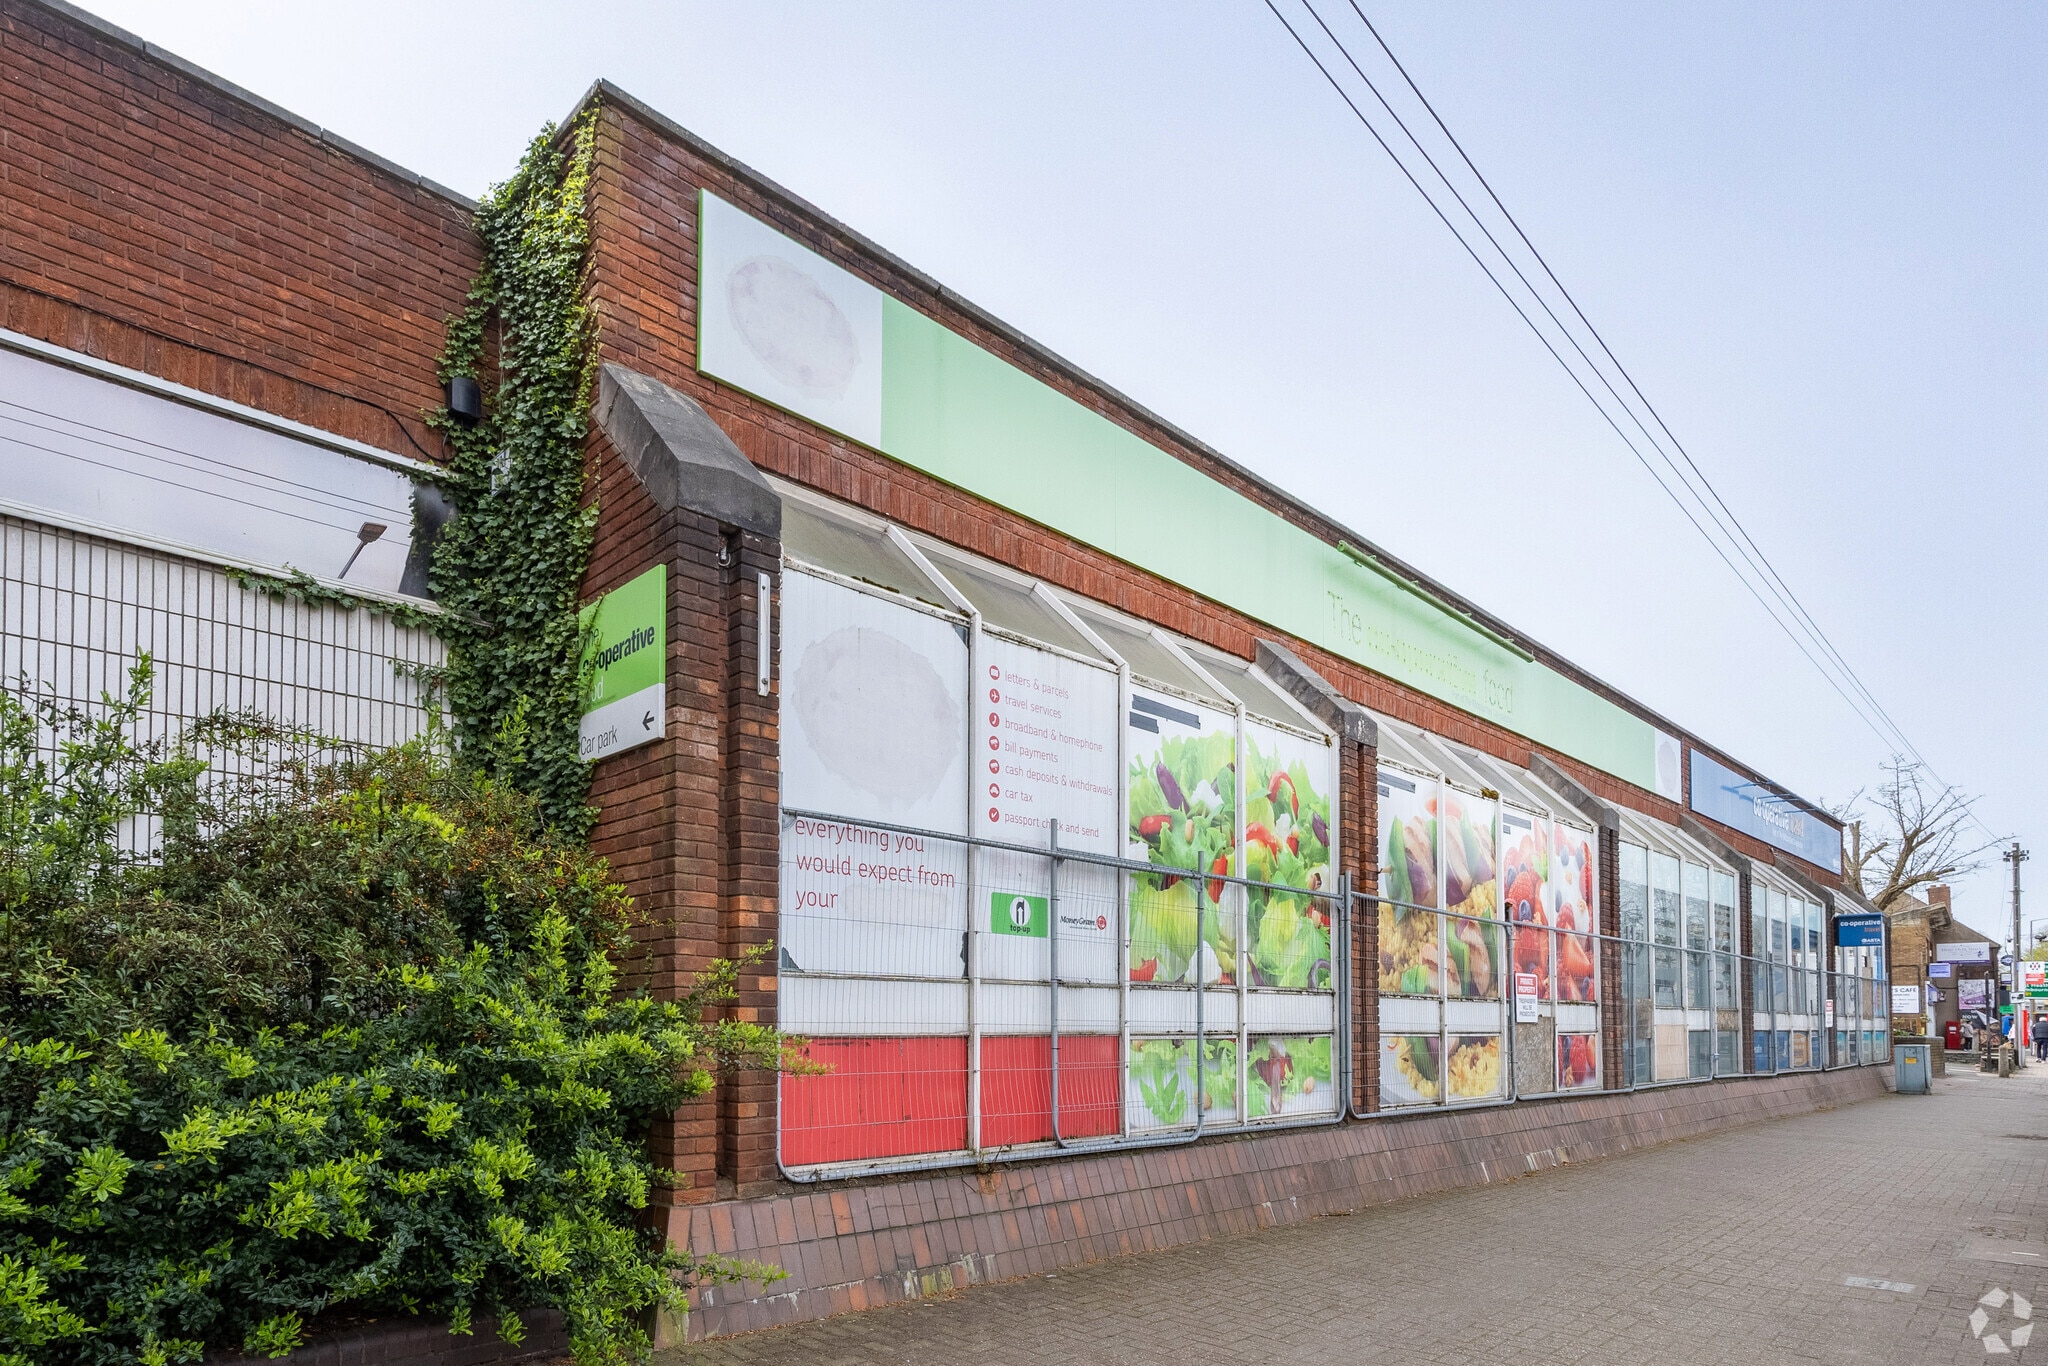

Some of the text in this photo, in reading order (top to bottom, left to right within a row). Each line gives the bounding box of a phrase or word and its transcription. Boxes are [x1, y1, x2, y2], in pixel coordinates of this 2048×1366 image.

[582, 626, 655, 677] c-operative
[1004, 670, 1070, 700] letters & parcels
[1004, 695, 1062, 719] travel services
[580, 725, 618, 756] Car park
[1004, 717, 1103, 753] broadband & homephone
[1004, 741, 1059, 763] bill payments
[1005, 765, 1113, 797] cash deposits & withdrawals
[1005, 788, 1033, 803] car tax
[794, 818, 925, 854] everything you
[1004, 812, 1100, 838] passport chk and send
[796, 853, 955, 889] would expect from
[795, 889, 839, 910] your
[1009, 924, 1031, 933] top-up
[1840, 919, 1881, 928] co-operative
